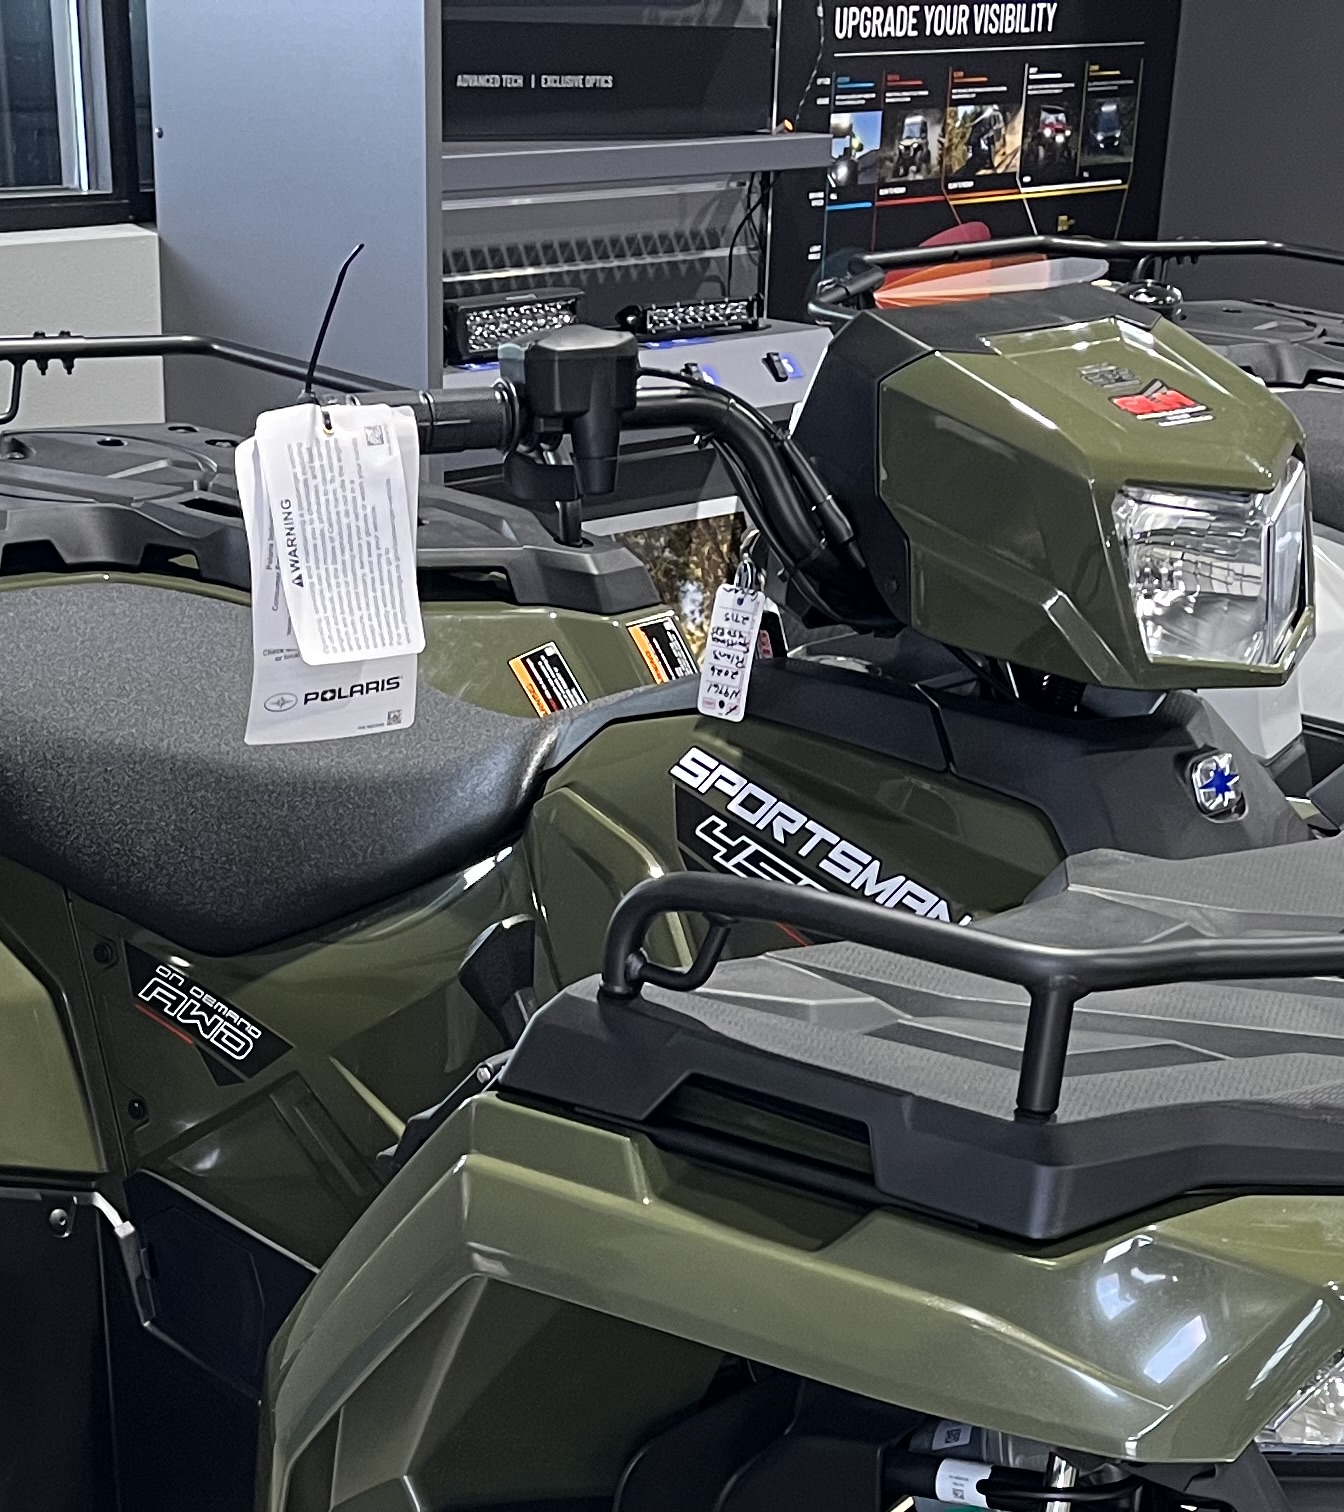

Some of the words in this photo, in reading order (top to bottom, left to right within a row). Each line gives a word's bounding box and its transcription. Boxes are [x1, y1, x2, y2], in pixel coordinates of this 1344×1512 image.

[834, 6, 921, 39] UPGRADE
[924, 4, 970, 36] YOUR
[973, 3, 1058, 34] VISIBILITY
[456, 74, 501, 88] ADVANCED
[501, 74, 524, 88] TECH
[540, 75, 584, 88] EXCLUSIVE
[584, 75, 613, 88] OPTICS
[280, 498, 301, 572] WARNING
[303, 675, 401, 706] POLARIS
[137, 977, 254, 1060] AWD
[155, 964, 185, 987] ON
[189, 986, 262, 1040] DEMAND
